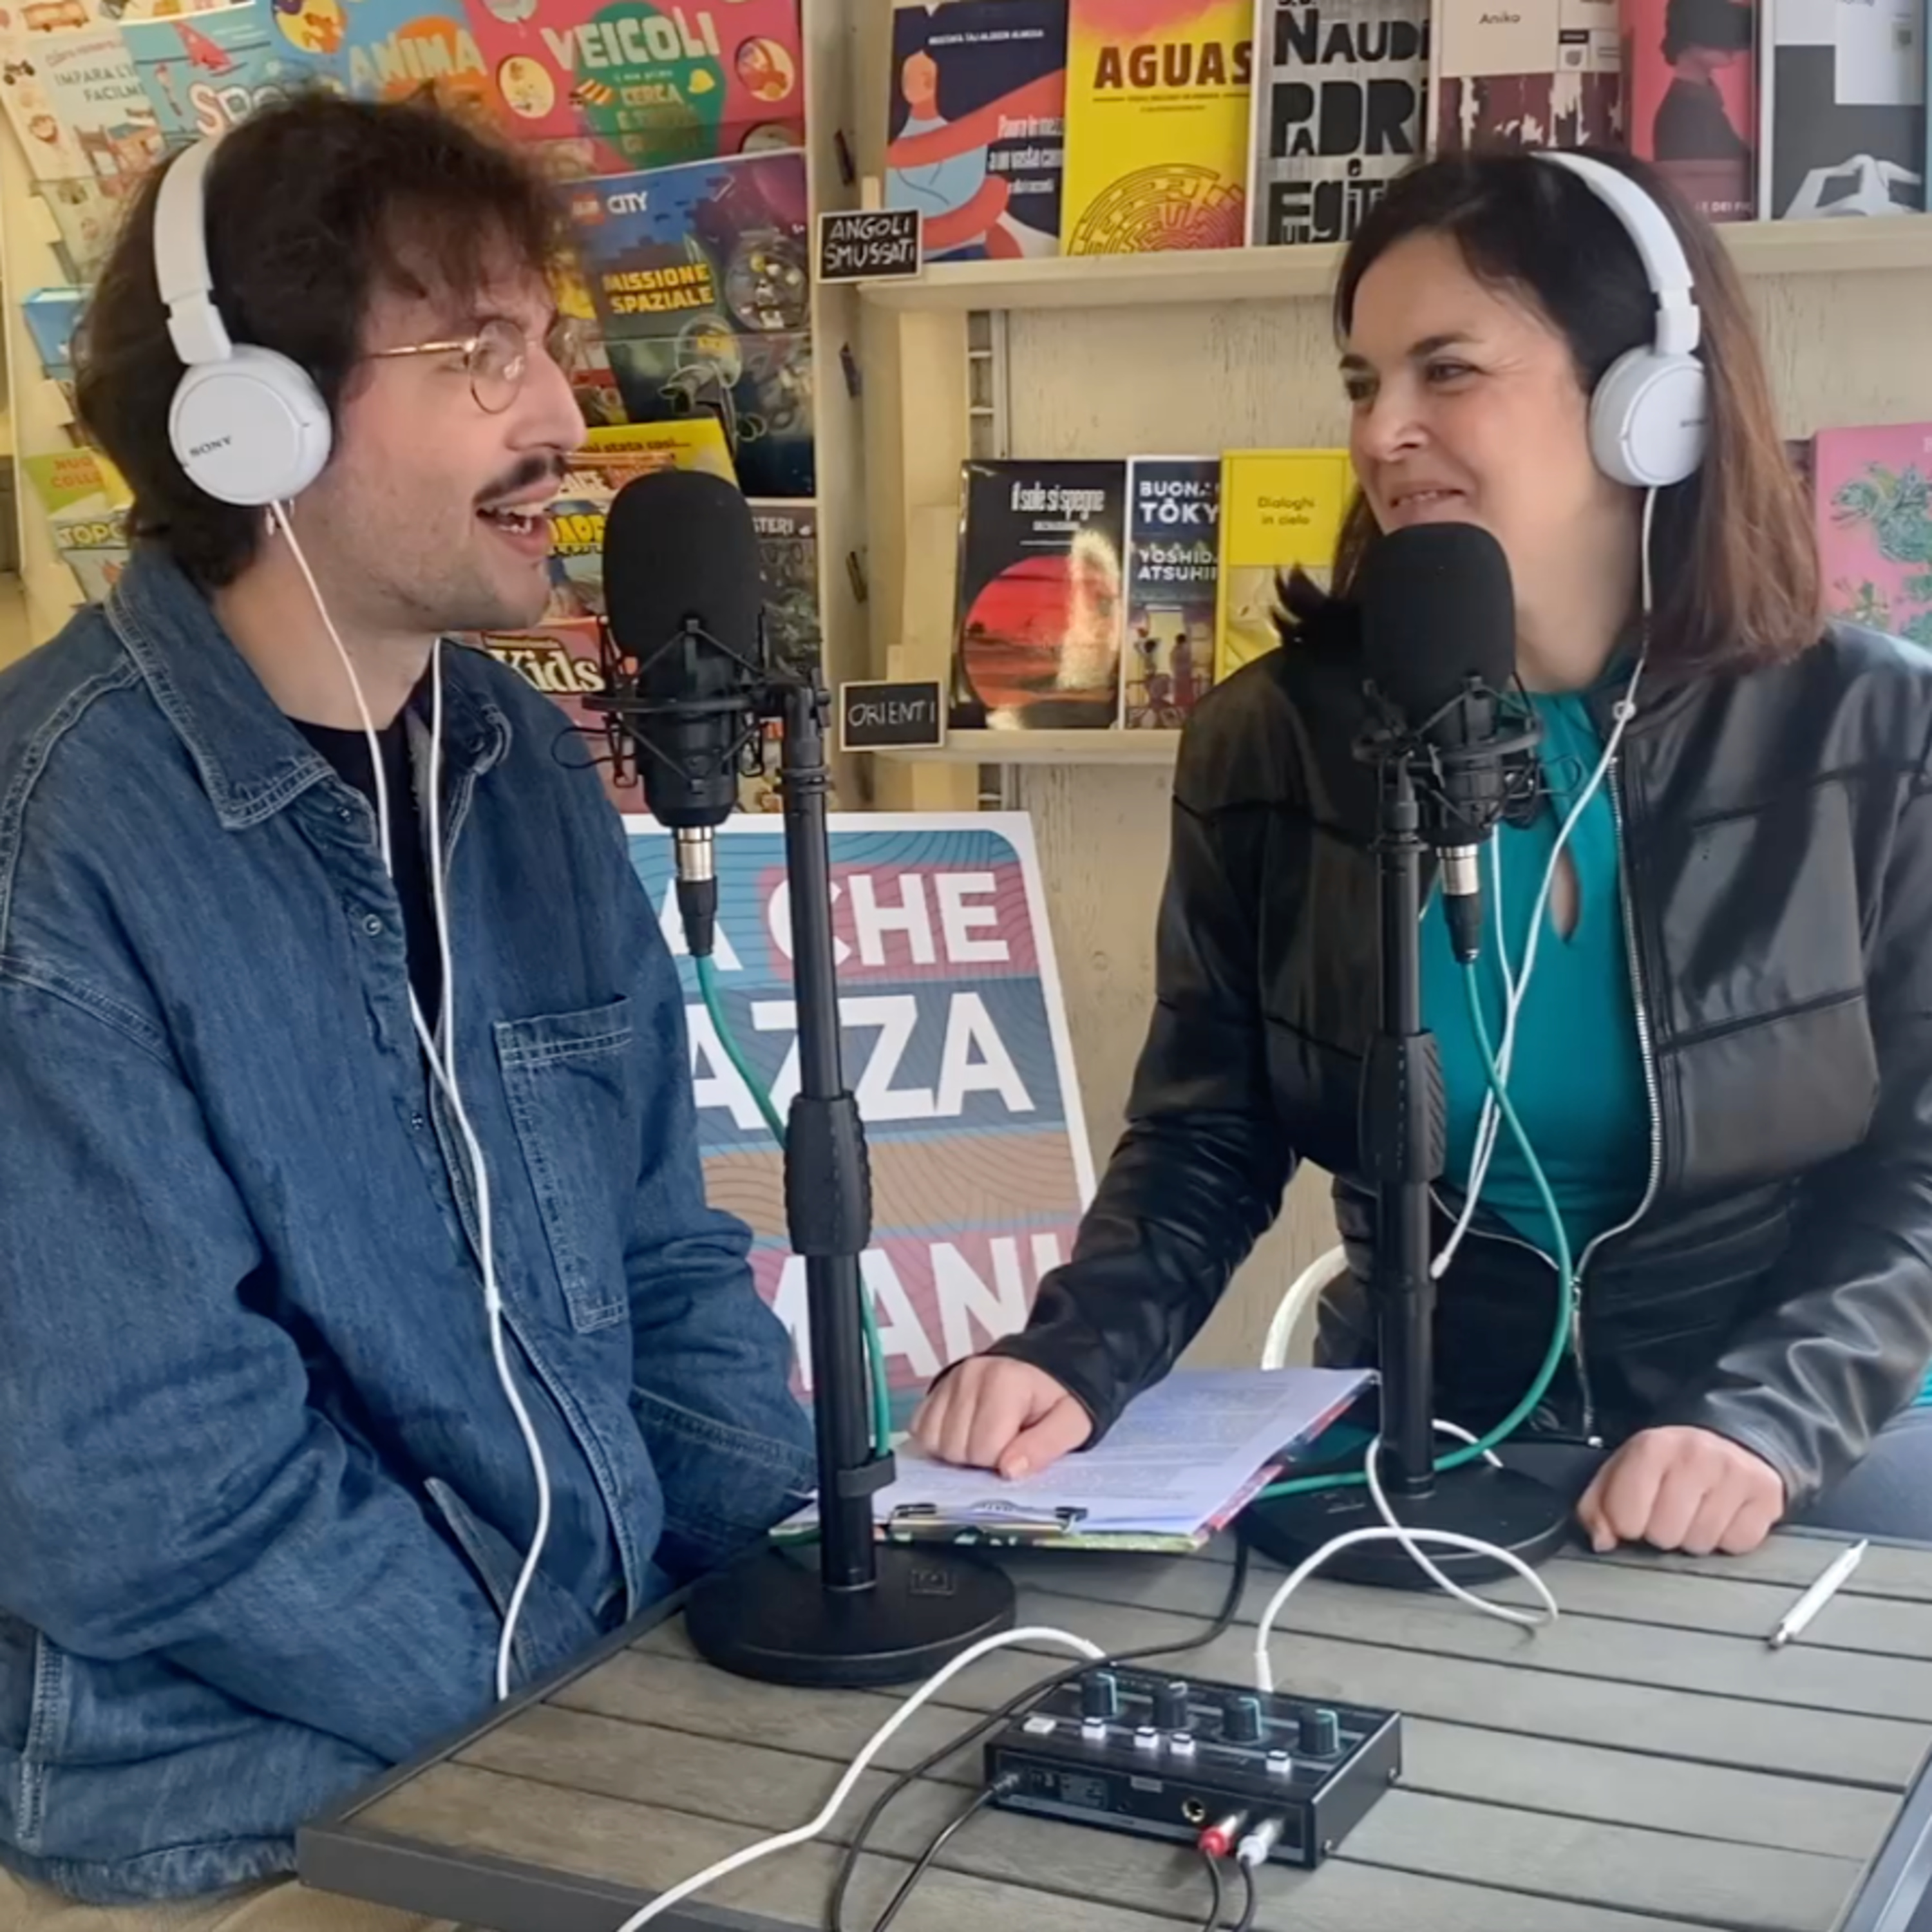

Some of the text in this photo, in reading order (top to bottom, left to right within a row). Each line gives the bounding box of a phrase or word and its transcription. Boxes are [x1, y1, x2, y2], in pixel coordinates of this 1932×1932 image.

[540, 6, 721, 71] VEICOLI
[350, 27, 488, 92] ANIMA
[1093, 40, 1253, 90] AGUAS
[54, 66, 117, 86] IMPARA
[607, 191, 648, 214] CITY
[830, 216, 909, 240] ANGOLI
[824, 238, 913, 270] SMUSSATI
[603, 263, 711, 292] MISSIONE
[611, 287, 715, 314] SPAZIALE
[189, 435, 232, 457] SONY
[1258, 496, 1315, 511] Dialoghi
[1138, 549, 1218, 564] YOSHID
[848, 700, 935, 727] ORIENTI
[768, 872, 1009, 965] CHE
